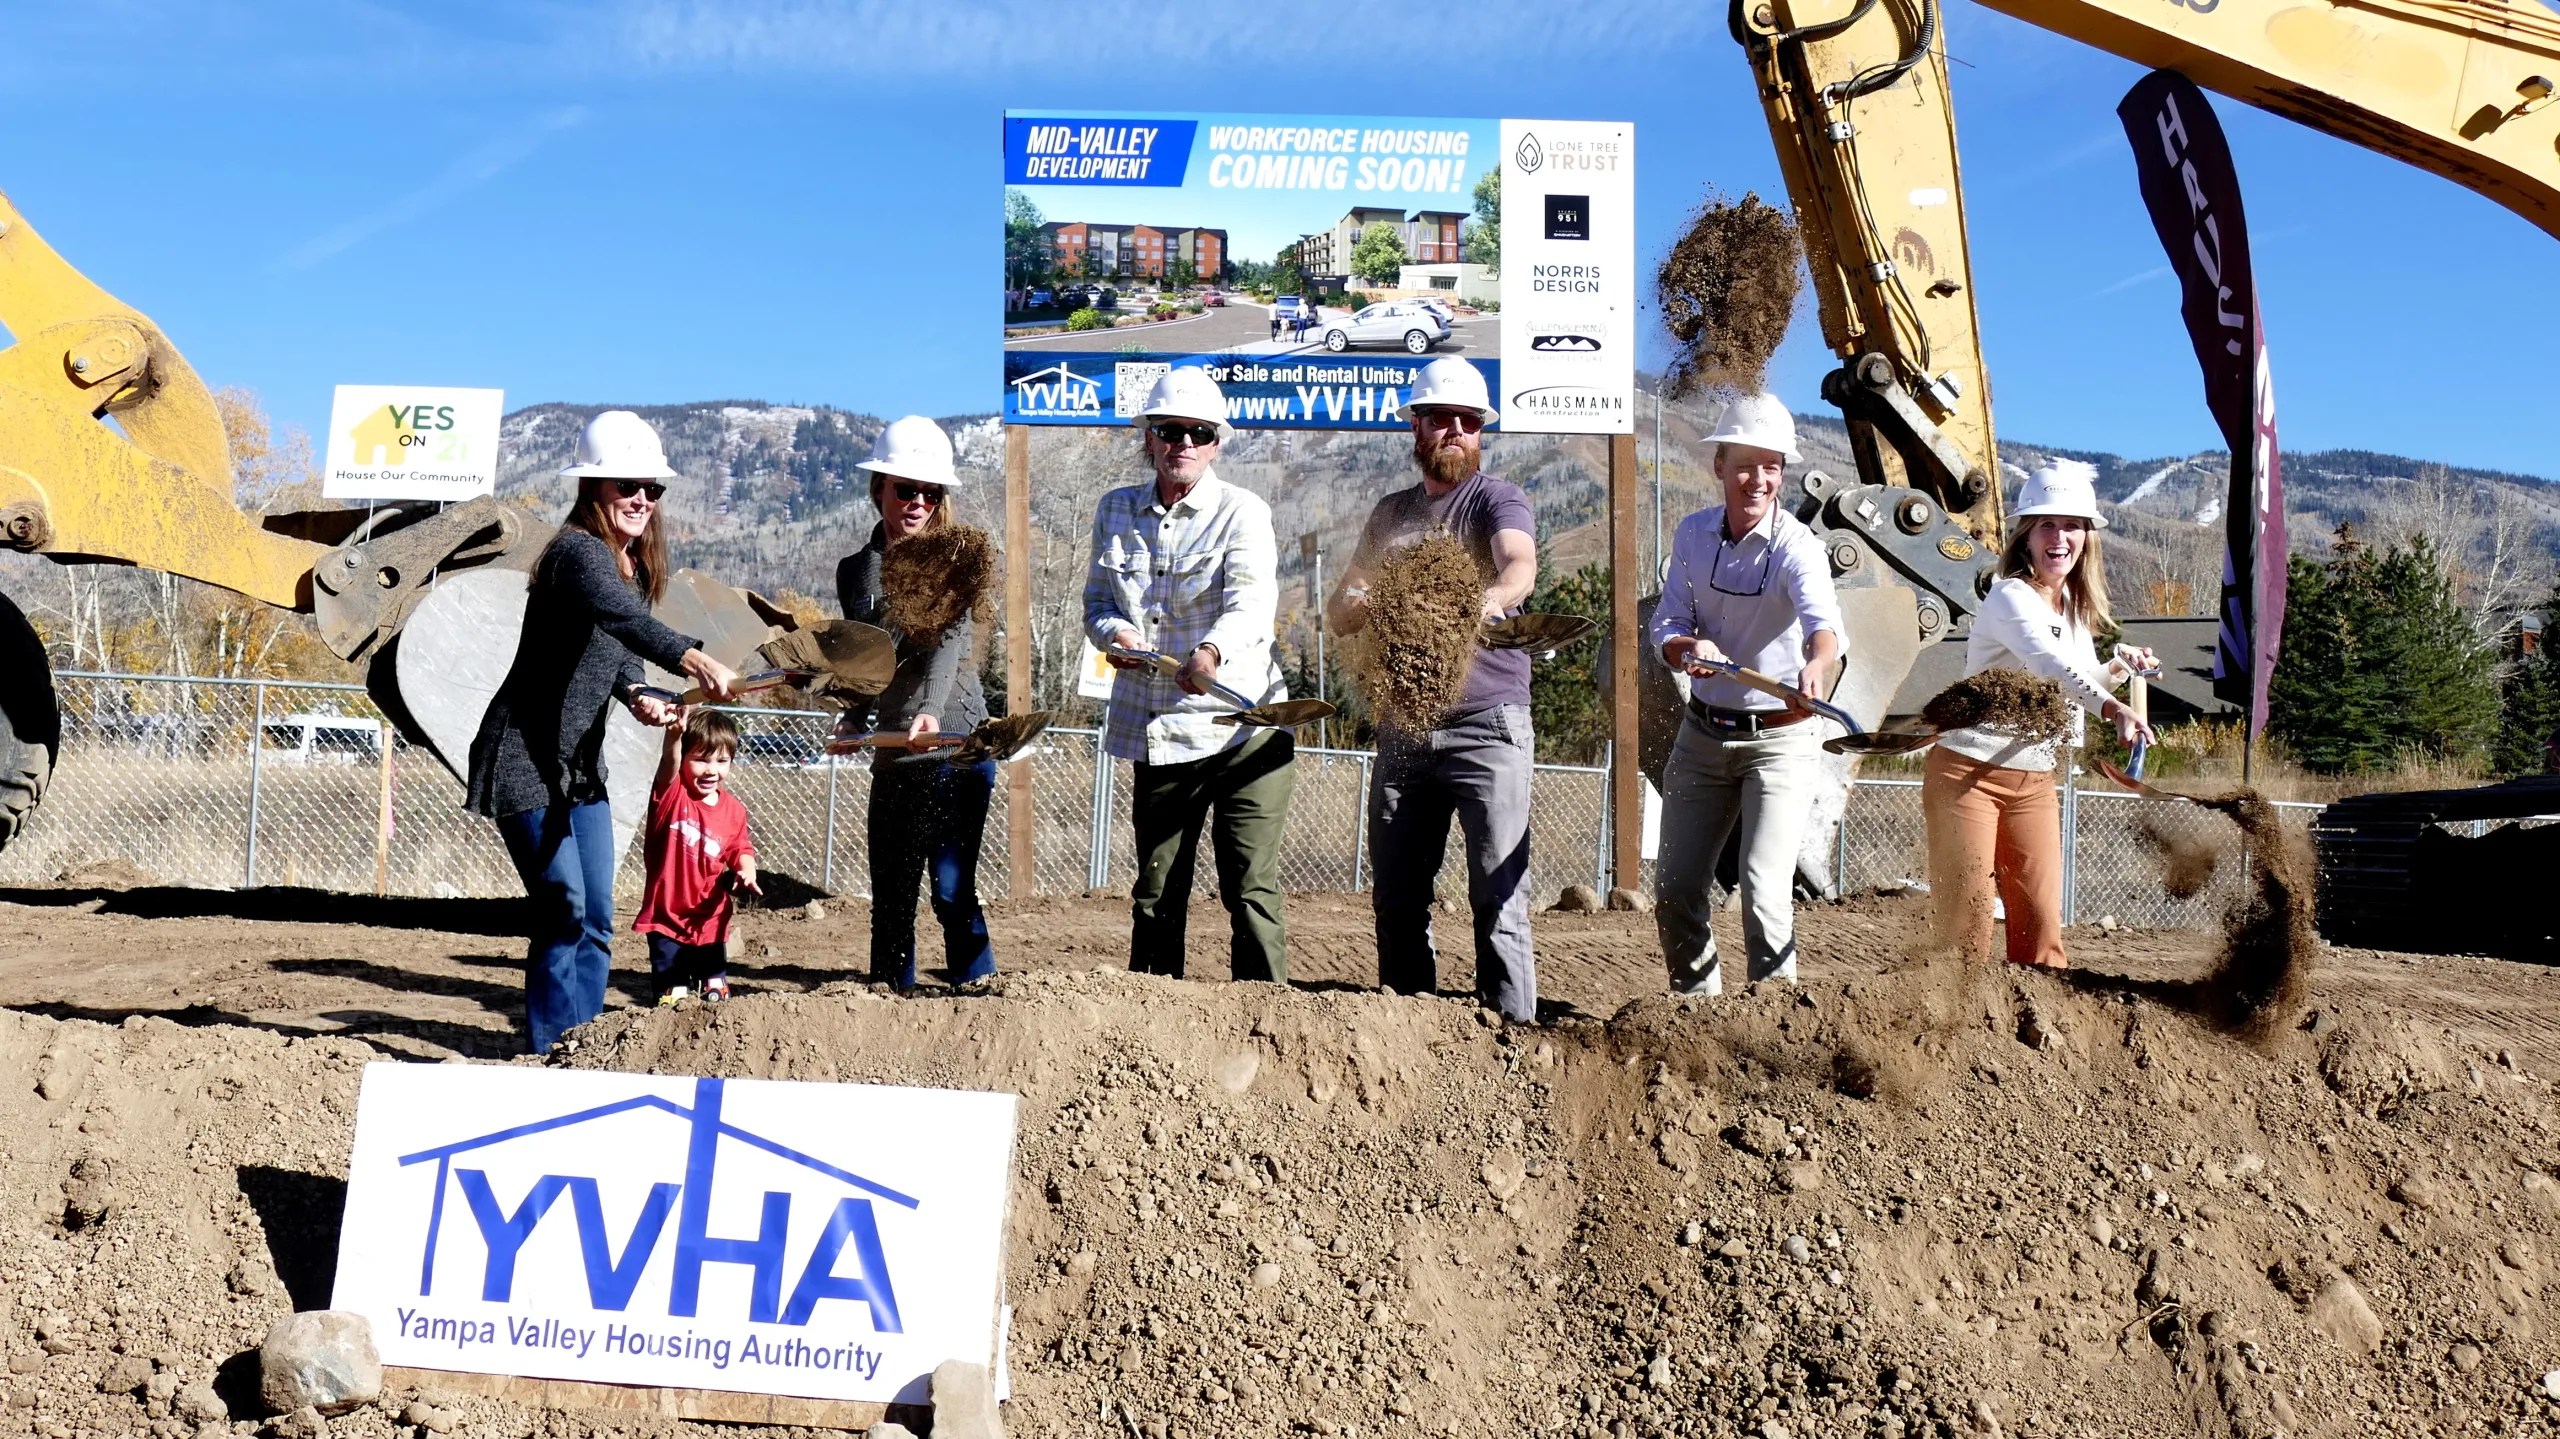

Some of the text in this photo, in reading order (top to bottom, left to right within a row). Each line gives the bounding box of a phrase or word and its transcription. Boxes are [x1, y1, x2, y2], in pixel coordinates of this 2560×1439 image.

[1026, 126, 1159, 156] MID-VALLEY
[1209, 126, 1471, 156] WORKFORCE HOUSING
[1549, 141, 1619, 153] LONE TREE
[1026, 156, 1152, 180] DEVELOPMENT
[1208, 153, 1467, 193] COMING SOON!
[1549, 153, 1619, 171] TRUST
[1557, 213, 1577, 223] 951
[1533, 264, 1601, 279] NORRIS
[1533, 279, 1600, 293] DESIGN
[1202, 366, 1230, 382] For
[1234, 364, 1268, 383] Sale
[1271, 365, 1302, 383] and
[1306, 366, 1358, 384] Rental
[1362, 366, 1404, 385] Units
[1021, 382, 1101, 409] YVHA
[1221, 385, 1404, 423] www.YVHA
[1528, 395, 1623, 410] HAUSMANN
[388, 404, 455, 431] YES
[399, 434, 427, 447] ON
[336, 470, 485, 485] House Our Community
[453, 1165, 904, 1335] YVHA
[396, 1307, 883, 1381] Yampa Valley Housing Authority
